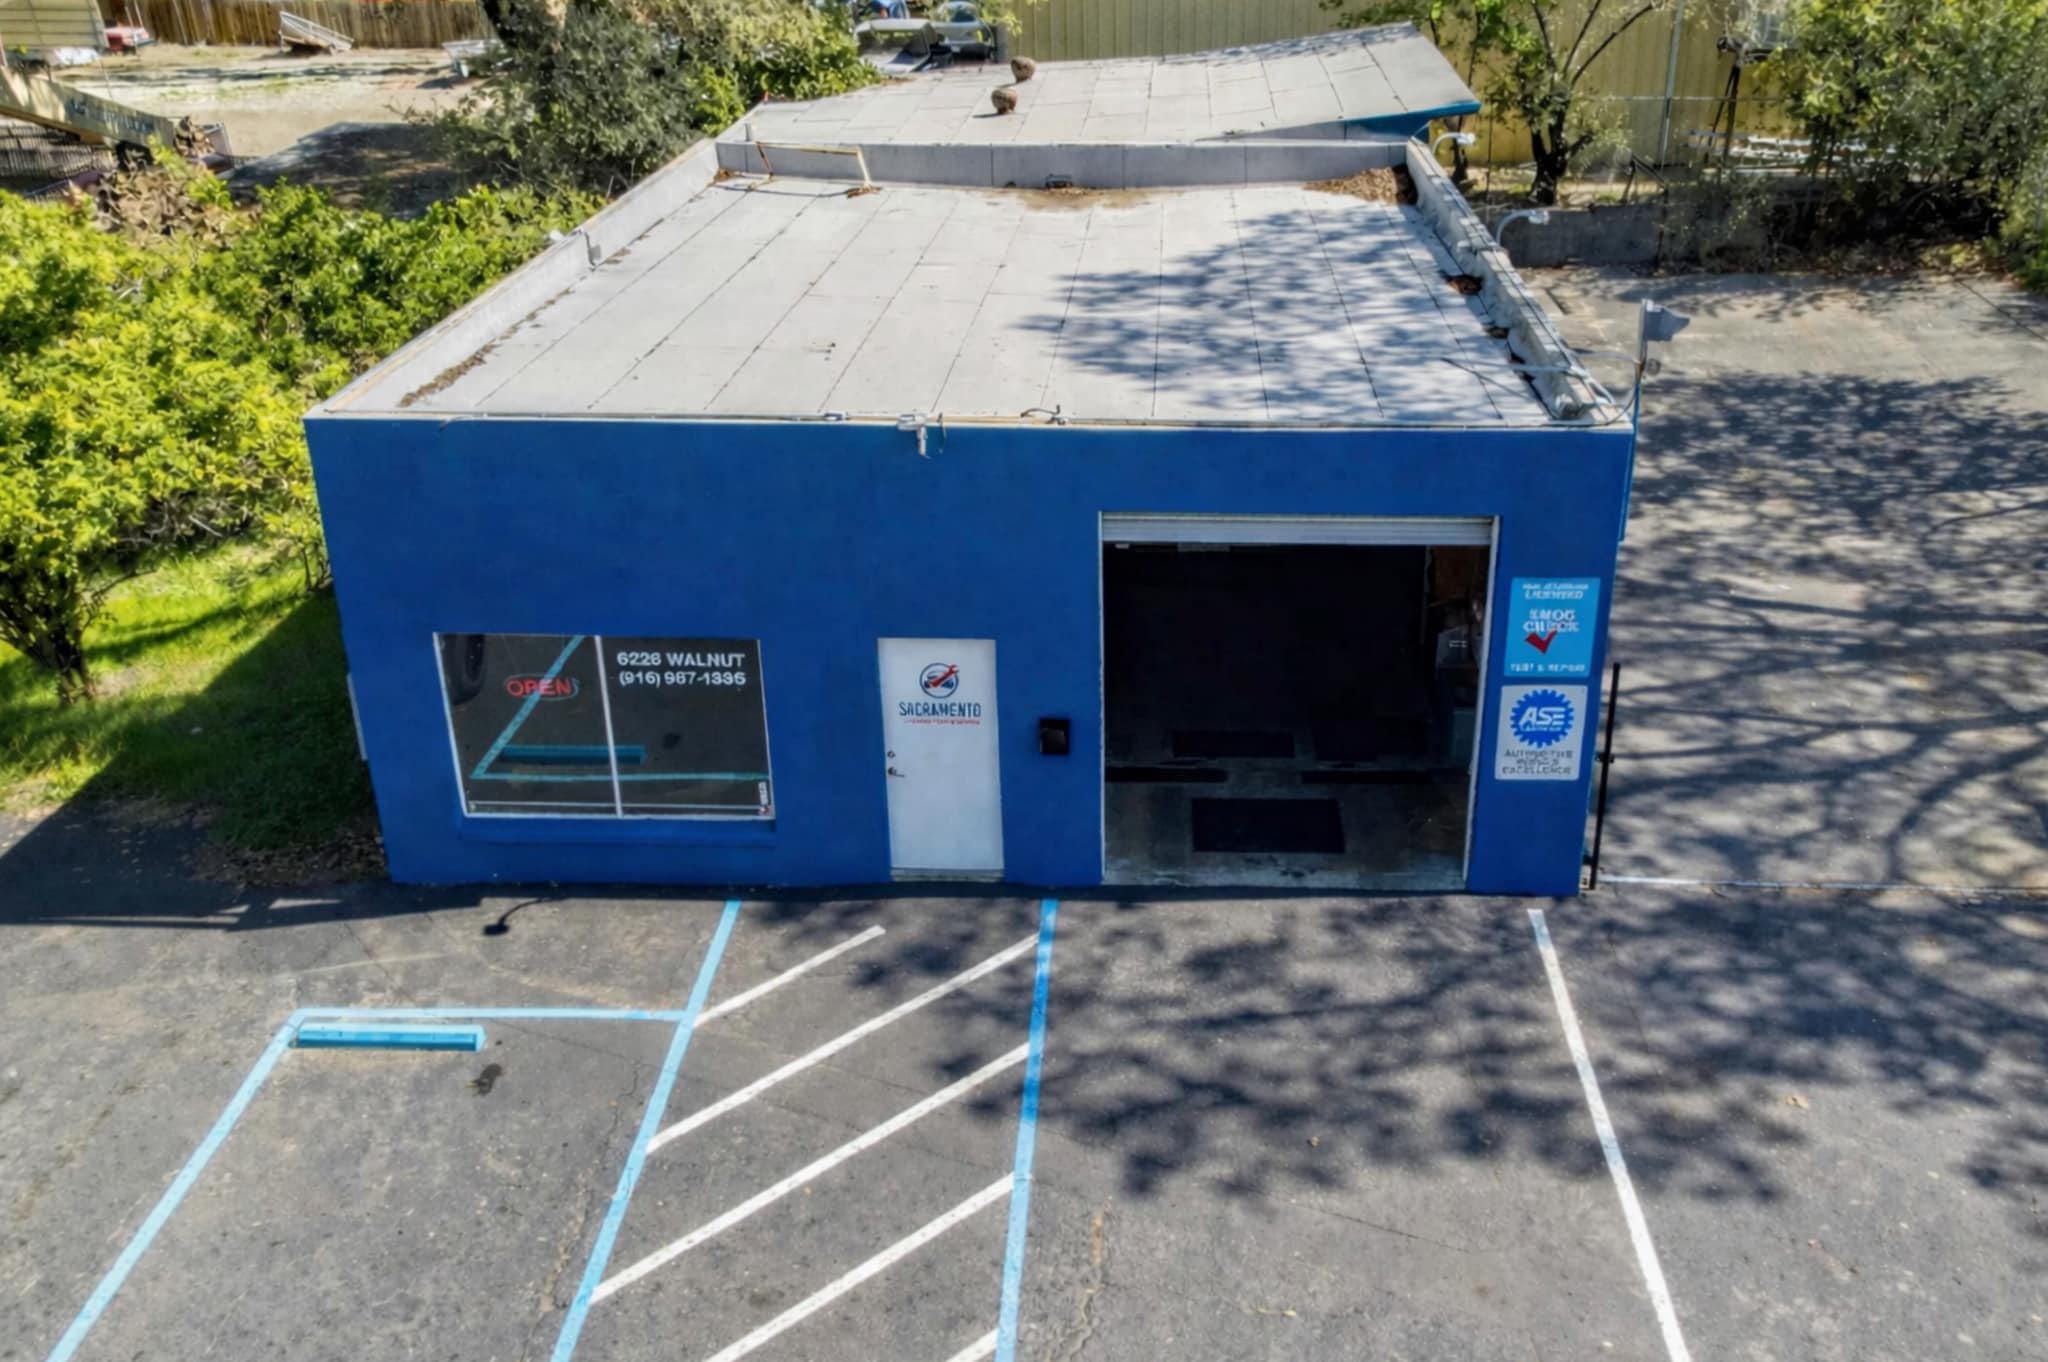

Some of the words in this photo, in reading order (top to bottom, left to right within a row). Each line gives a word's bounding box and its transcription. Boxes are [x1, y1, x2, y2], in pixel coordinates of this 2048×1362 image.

[665, 652, 746, 668] WALNUT
[506, 678, 572, 697] OPEN
[619, 670, 661, 688] (916)
[898, 701, 982, 718] SACRAMENTO
[1518, 706, 1566, 729] ASE
